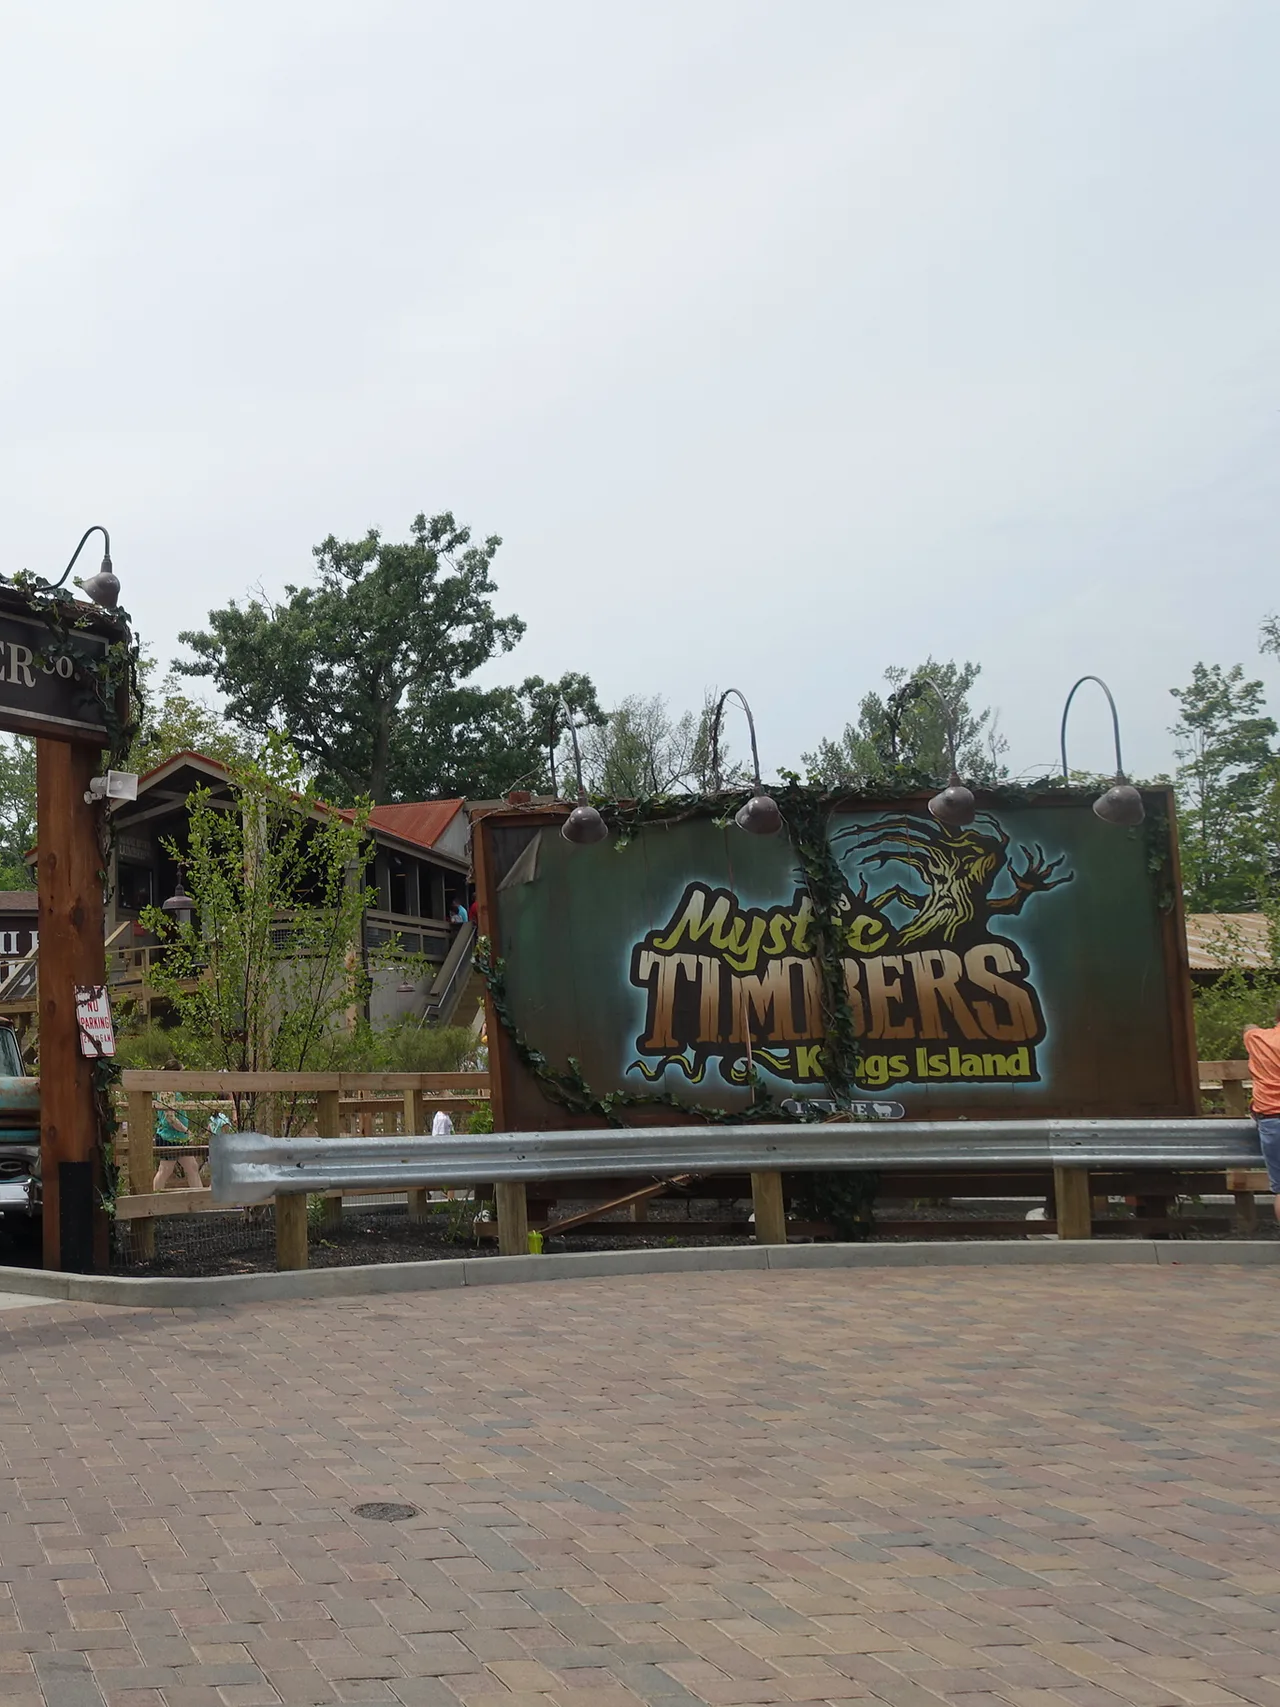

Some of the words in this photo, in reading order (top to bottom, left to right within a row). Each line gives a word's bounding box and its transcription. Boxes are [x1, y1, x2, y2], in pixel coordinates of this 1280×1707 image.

[652, 888, 890, 971] Mystc
[80, 1016, 110, 1030] PARKING
[638, 942, 1038, 1048] TIMBERS
[795, 1045, 910, 1085] Kgs
[915, 1046, 1031, 1078] Island
